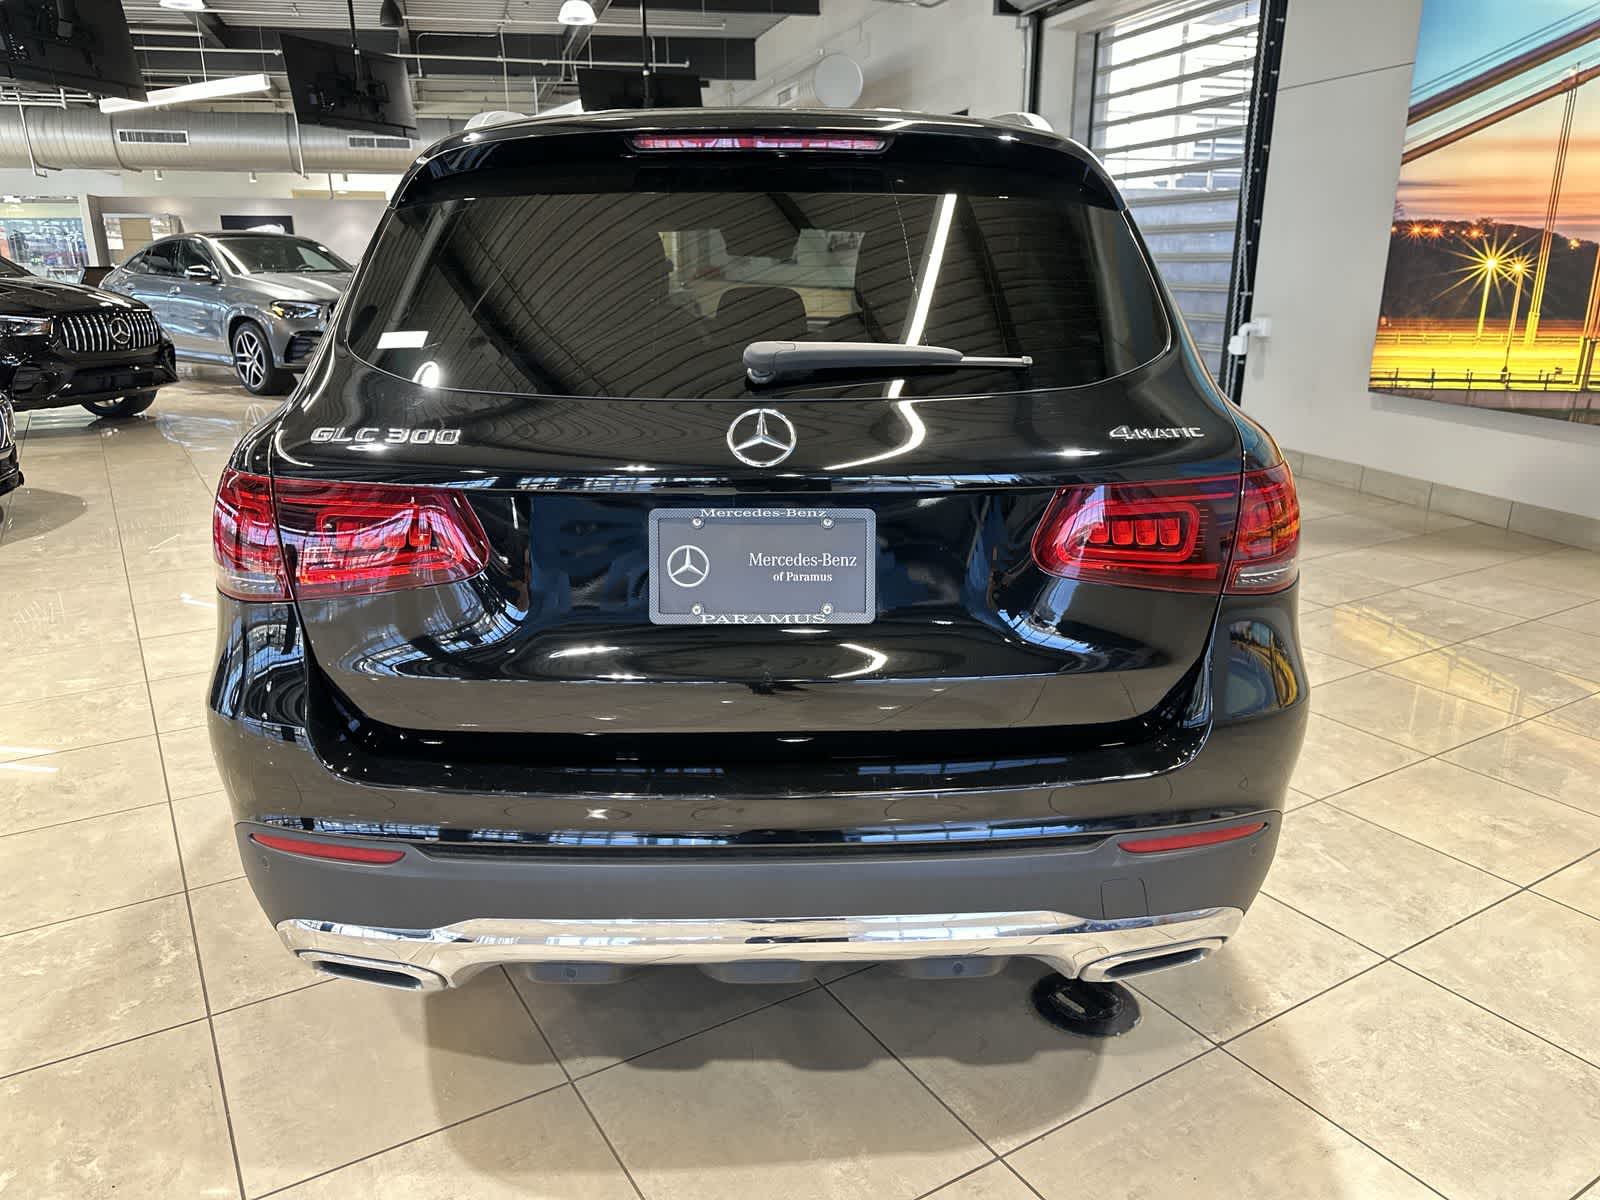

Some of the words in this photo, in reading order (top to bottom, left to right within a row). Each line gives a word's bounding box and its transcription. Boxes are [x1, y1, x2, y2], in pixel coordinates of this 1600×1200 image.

[310, 427, 379, 443] GLC
[384, 428, 461, 445] 300
[1109, 425, 1205, 440] 4MATIC
[700, 508, 827, 518] Mercedes-Benz
[749, 552, 857, 567] Mercedes-Benz
[773, 572, 784, 582] of
[786, 572, 833, 582] Paramus
[700, 614, 826, 624] PARAMUS
